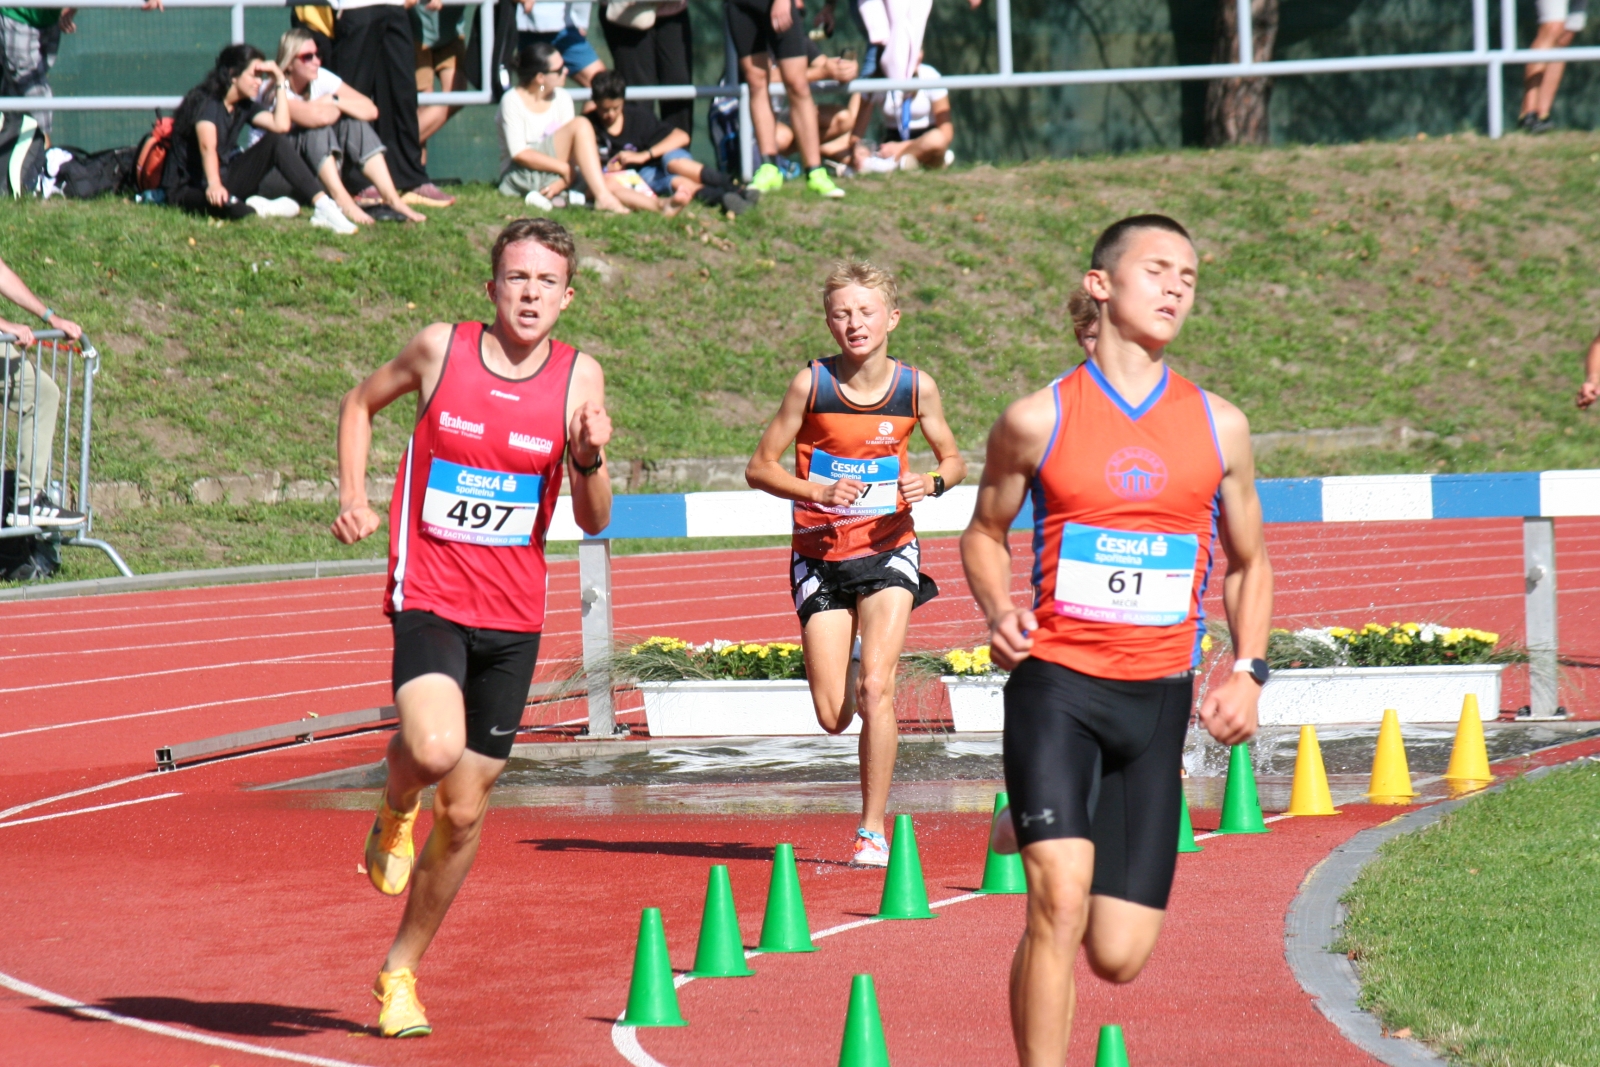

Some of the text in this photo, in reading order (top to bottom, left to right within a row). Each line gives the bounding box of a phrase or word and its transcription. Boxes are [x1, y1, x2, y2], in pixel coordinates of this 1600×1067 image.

[509, 431, 554, 447] MARATON
[831, 460, 866, 474] ČESKÁ
[457, 470, 500, 491] ČESKÁ
[455, 485, 495, 498] spořitelna
[446, 499, 515, 532] 497
[443, 529, 471, 541] ŽACTVA
[476, 535, 508, 544] BLANSKO
[1096, 533, 1149, 556] ČESKÁ
[1094, 552, 1143, 566] spořitelna
[1107, 570, 1143, 595] 61
